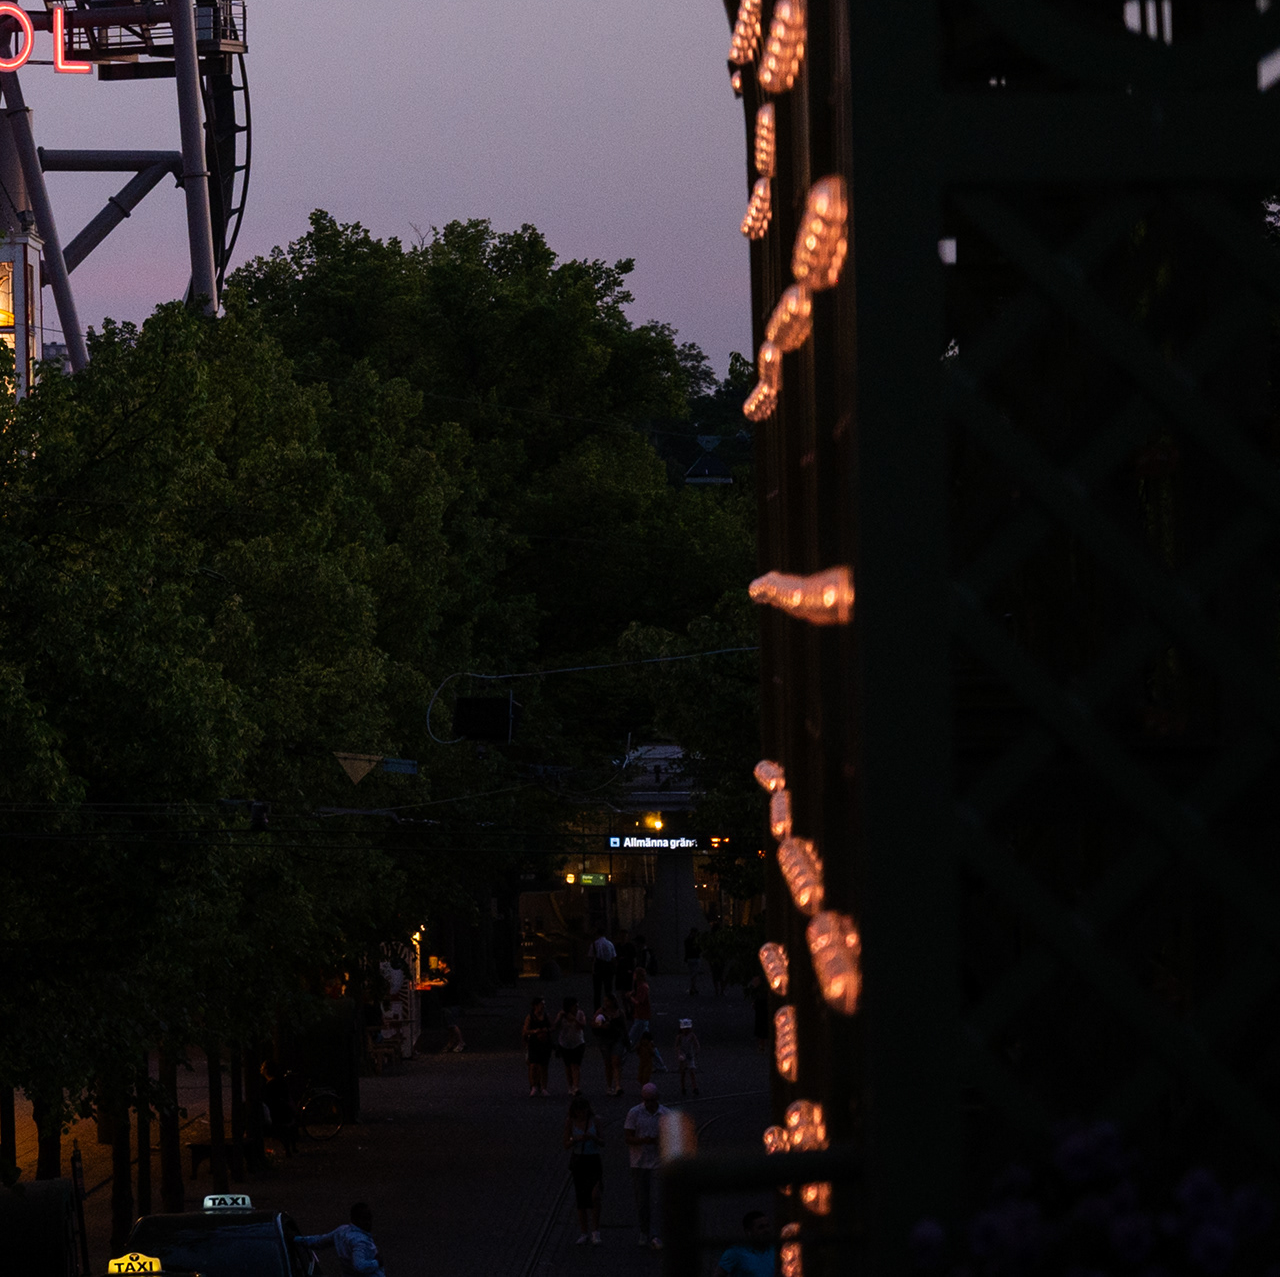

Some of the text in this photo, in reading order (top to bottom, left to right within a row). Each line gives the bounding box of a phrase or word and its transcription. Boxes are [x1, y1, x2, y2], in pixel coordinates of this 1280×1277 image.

[623, 837, 669, 847] Allmänna
[209, 1196, 246, 1206] TAXI
[114, 1261, 153, 1273] TAXI
